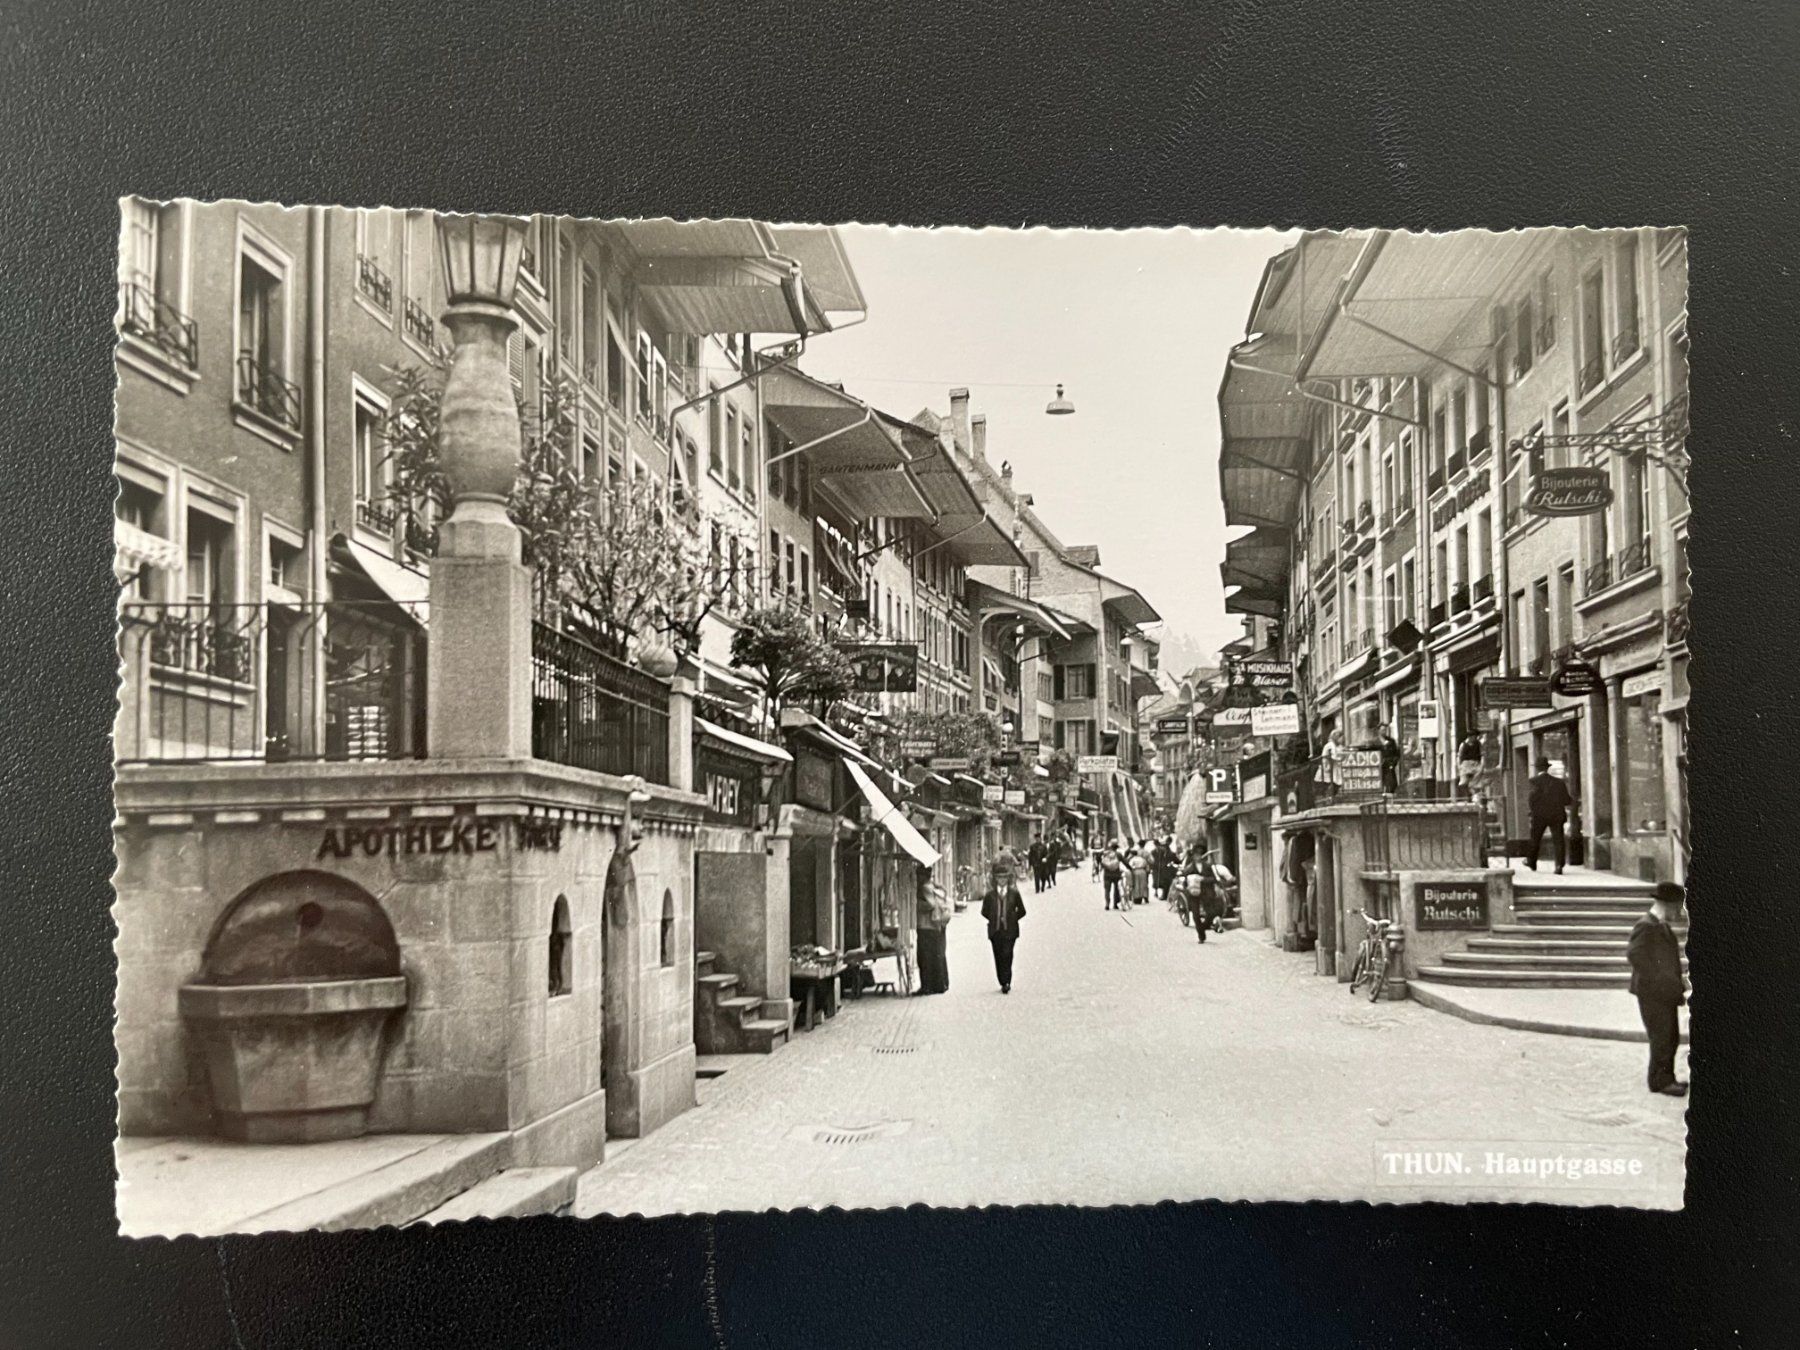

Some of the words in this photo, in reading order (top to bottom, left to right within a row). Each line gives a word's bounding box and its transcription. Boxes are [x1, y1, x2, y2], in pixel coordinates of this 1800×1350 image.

[1541, 476, 1599, 491] Bijouterie
[1247, 663, 1292, 674] MUSIKHAUS
[1209, 768, 1227, 791] P
[316, 822, 498, 861] APOTHEKE
[1424, 888, 1478, 904] Bijouterie
